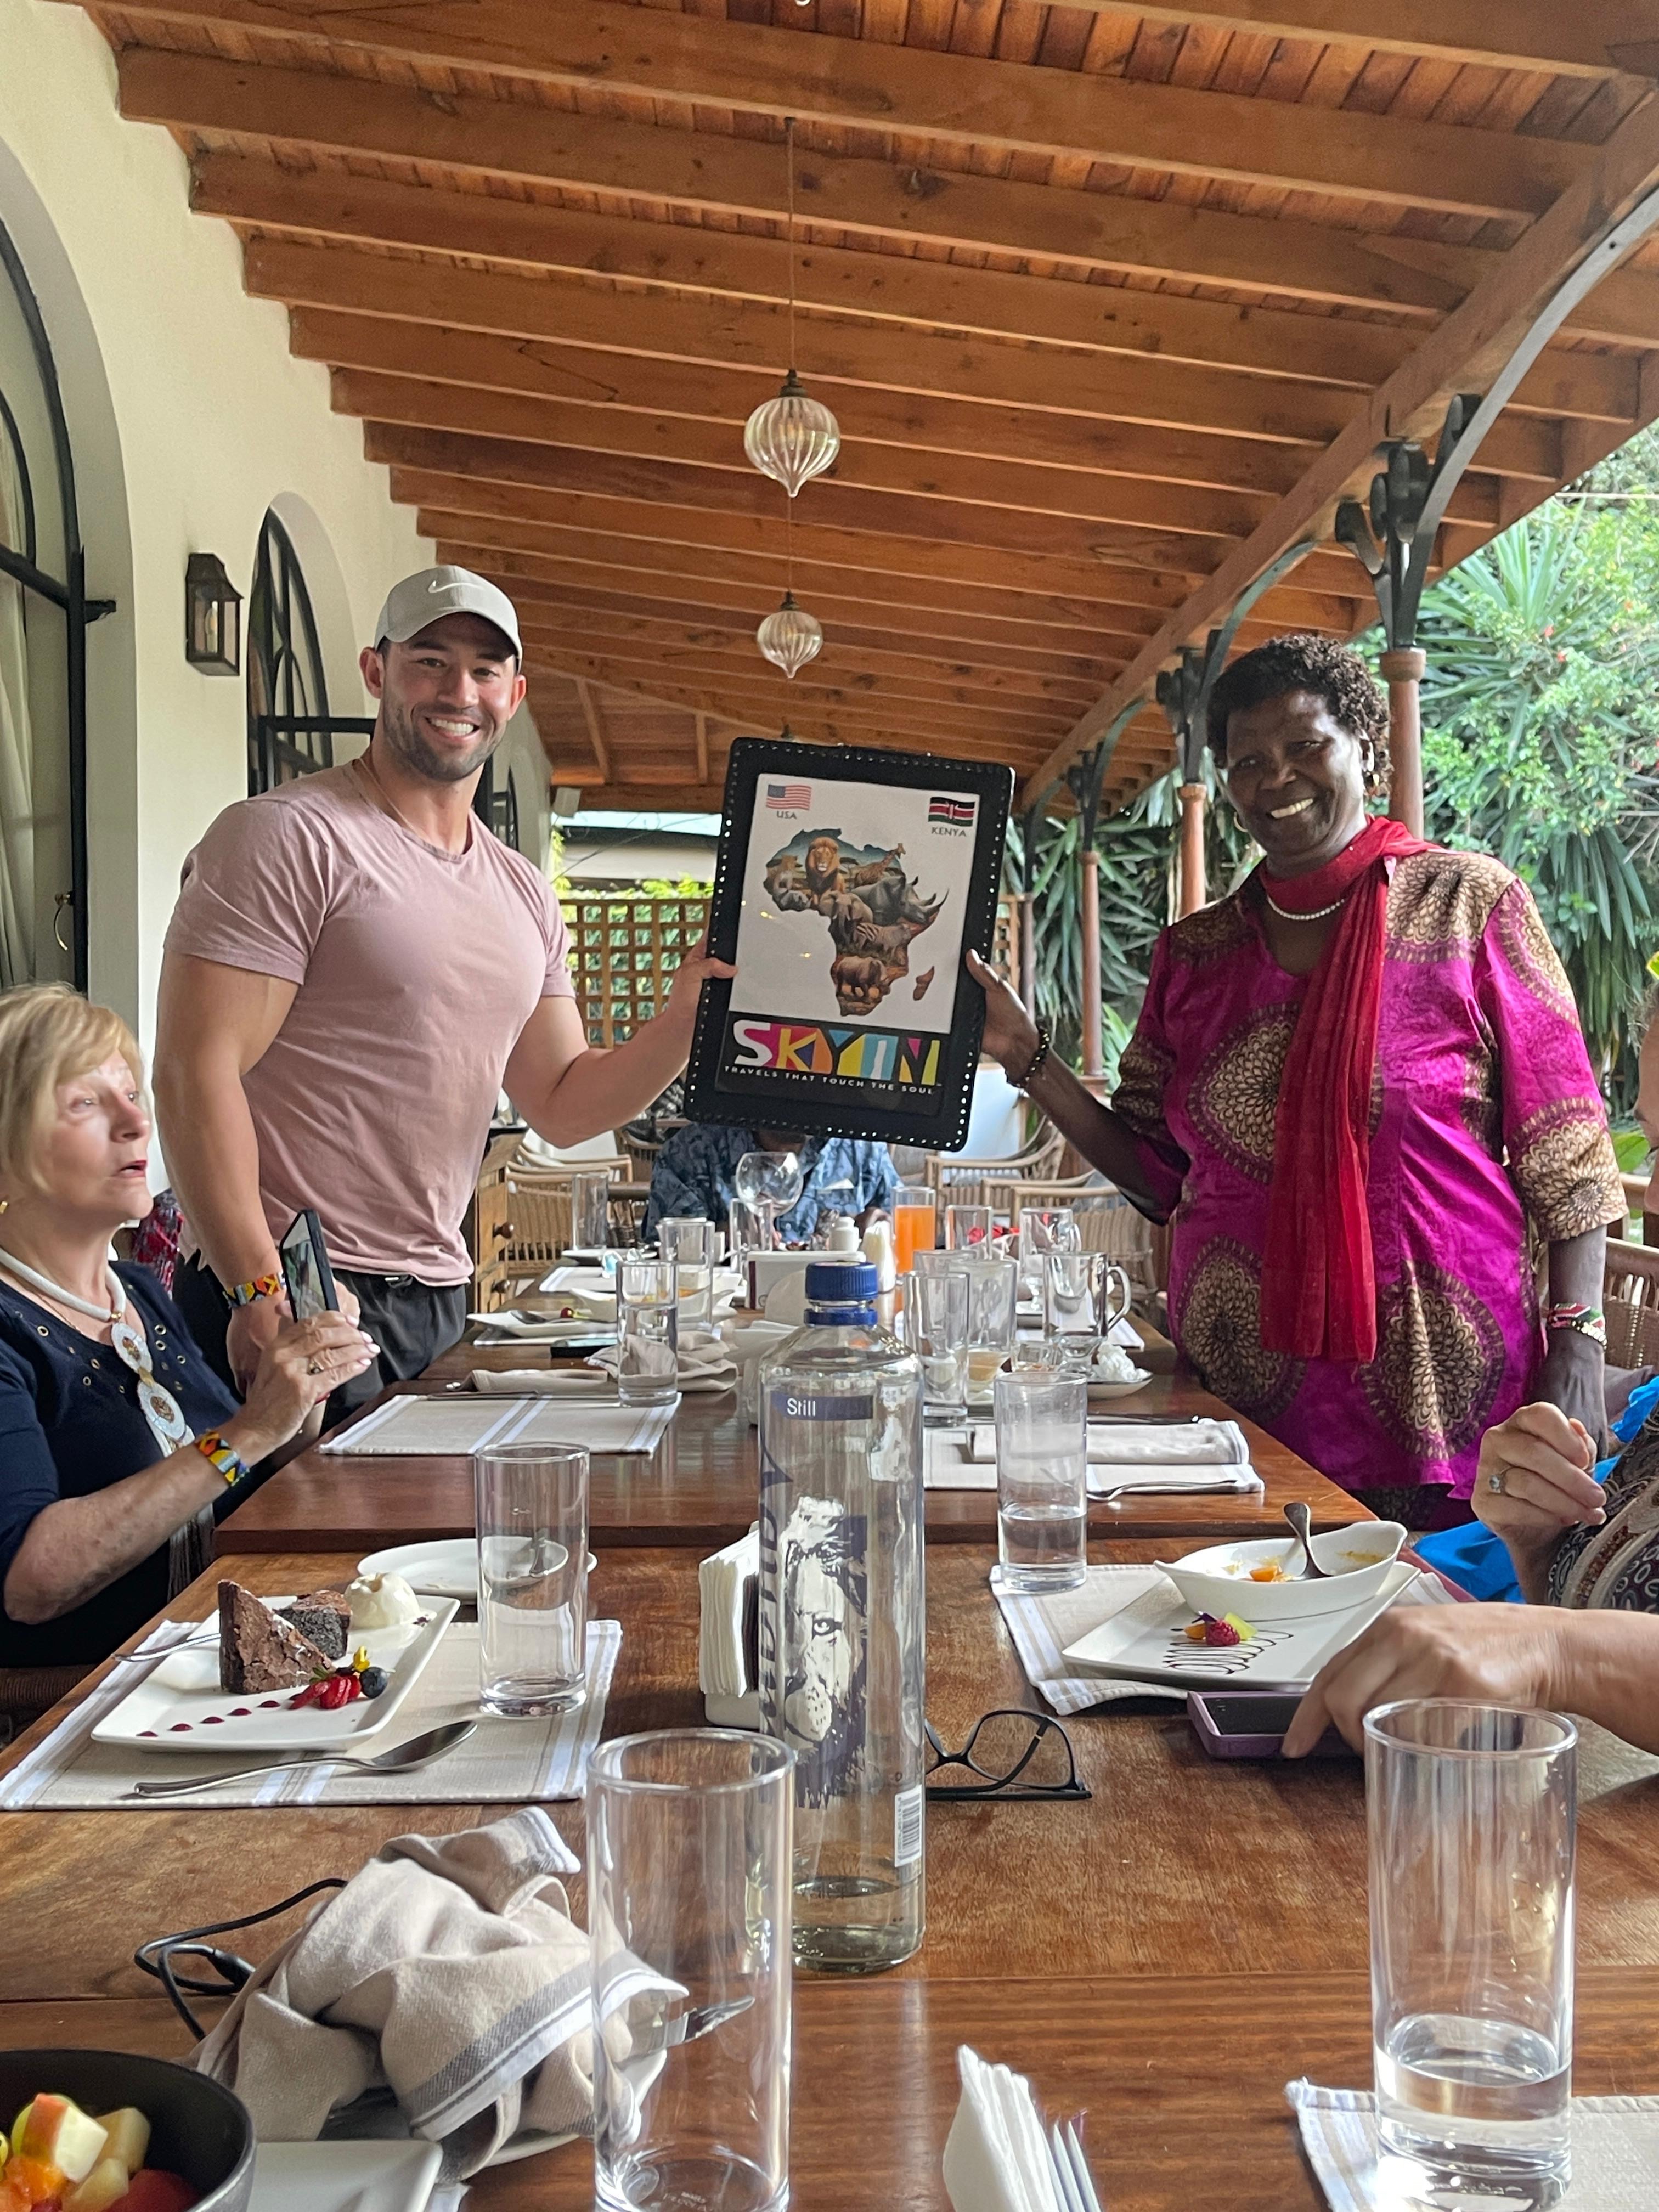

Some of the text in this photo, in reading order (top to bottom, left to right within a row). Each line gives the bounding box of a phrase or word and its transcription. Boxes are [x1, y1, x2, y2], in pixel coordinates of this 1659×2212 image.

[777, 811, 797, 820] USA
[932, 827, 967, 837] KENYA
[725, 1066, 933, 1094] TRAVELS THAT TOUCH THE SOUL
[787, 1398, 816, 1417] Still
